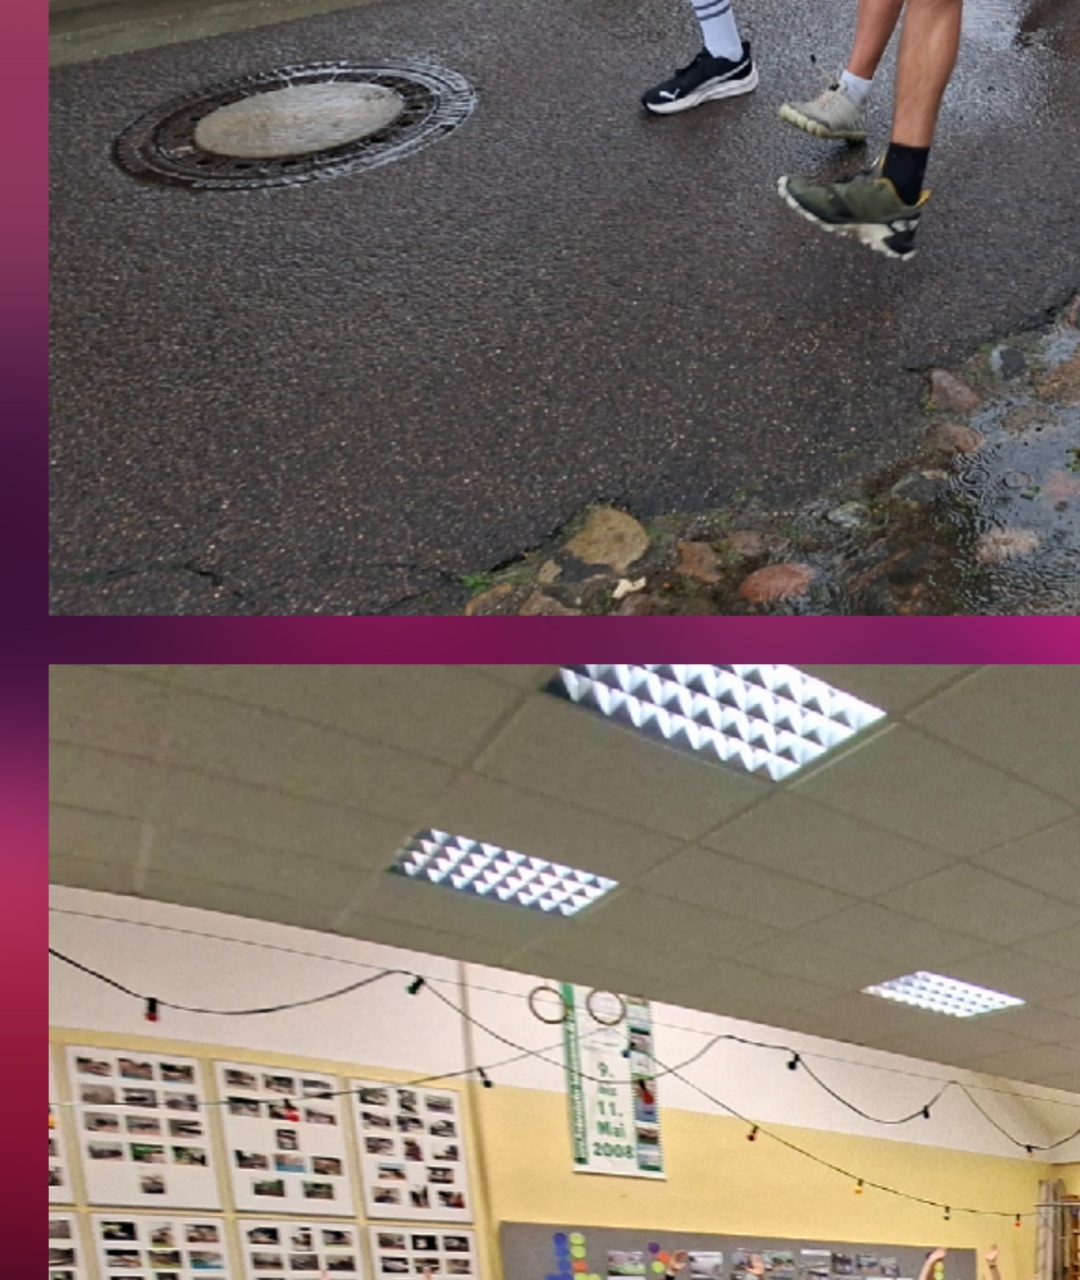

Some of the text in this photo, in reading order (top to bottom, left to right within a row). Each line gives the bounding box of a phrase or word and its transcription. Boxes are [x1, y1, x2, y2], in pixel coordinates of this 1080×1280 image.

[597, 1061, 615, 1078] 9.
[597, 1100, 624, 1117] 11.
[597, 1120, 626, 1138] Mai
[593, 1142, 634, 1159] 2008
